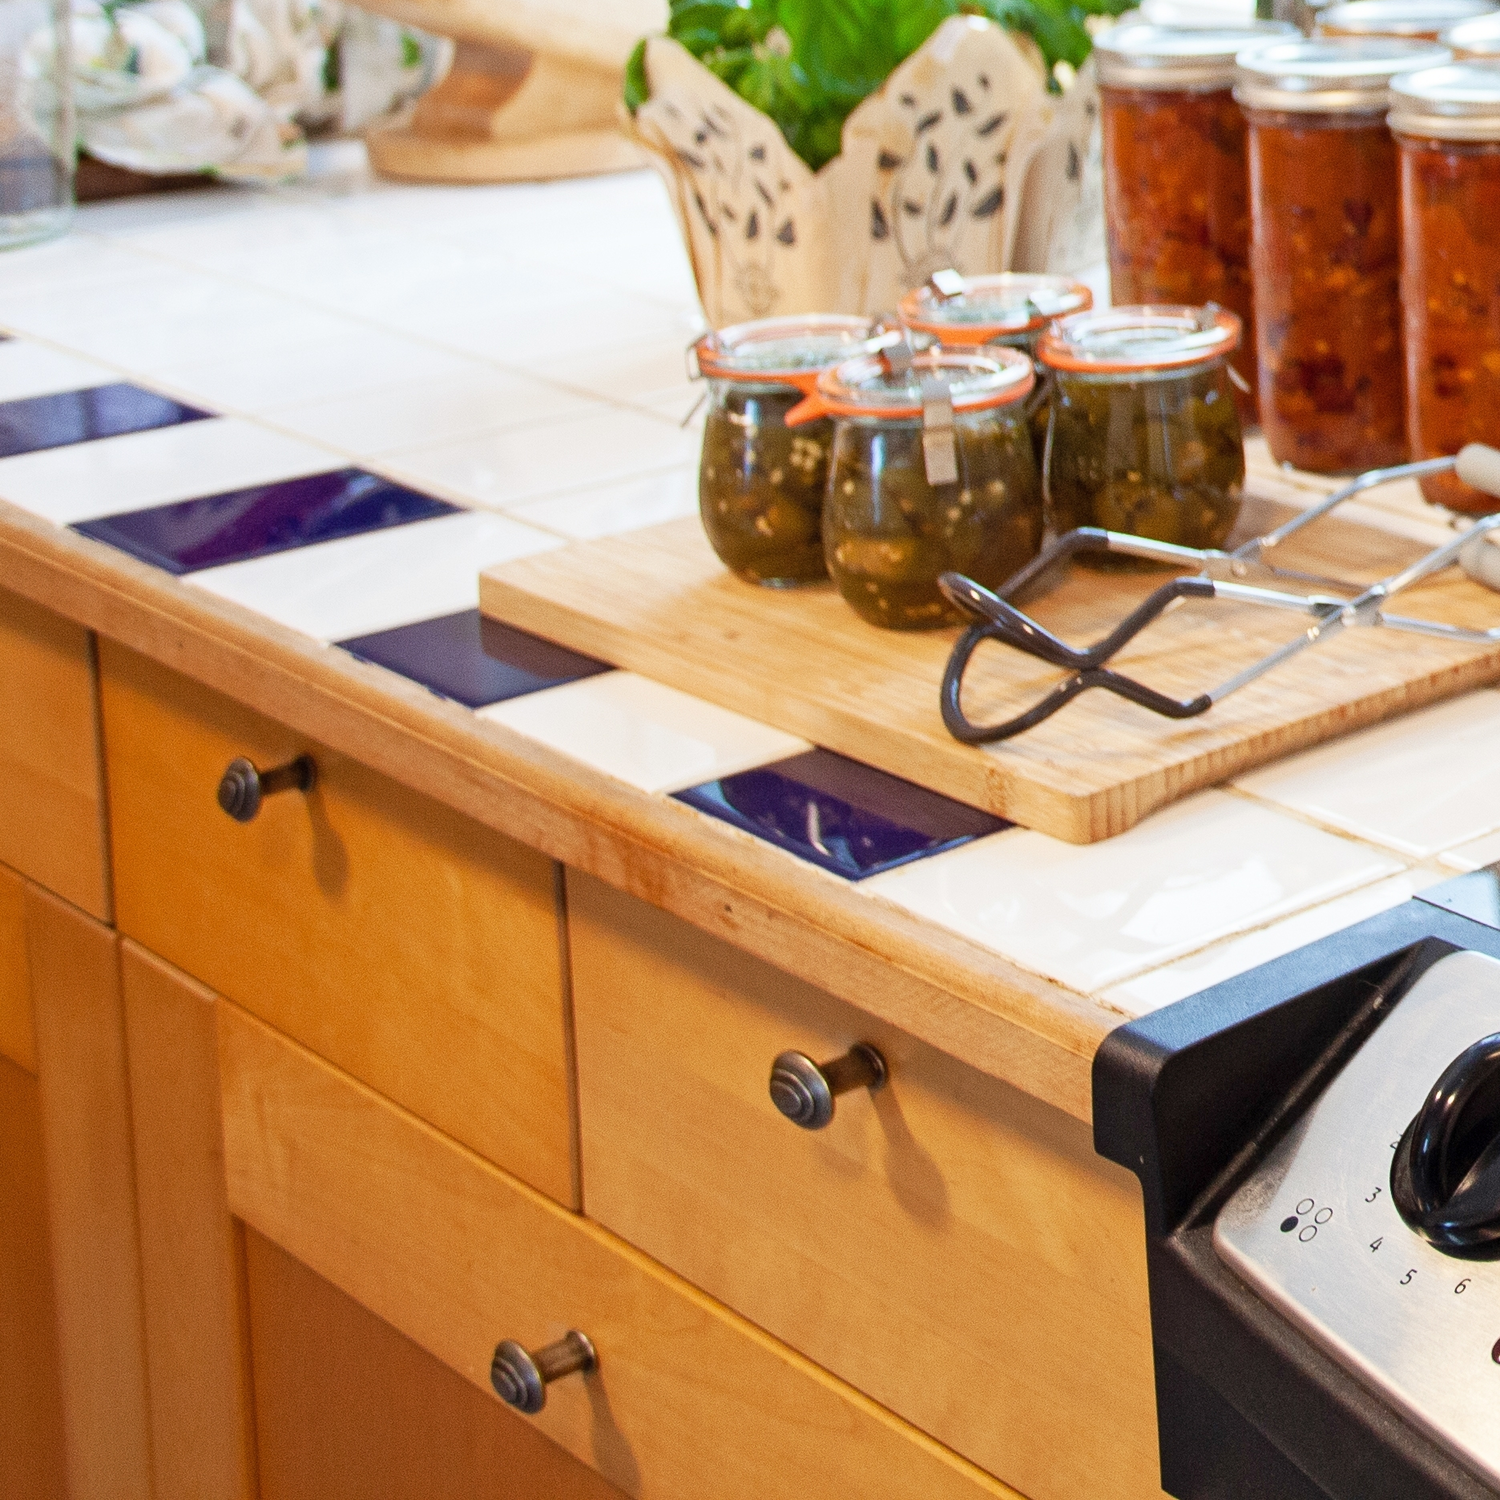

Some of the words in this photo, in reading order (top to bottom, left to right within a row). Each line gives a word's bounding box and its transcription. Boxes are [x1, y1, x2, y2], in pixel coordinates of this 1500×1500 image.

[1365, 1186, 1382, 1203] 3
[1370, 1237, 1384, 1253] 4
[1400, 1268, 1417, 1285] 5
[1454, 1278, 1471, 1294] 6
